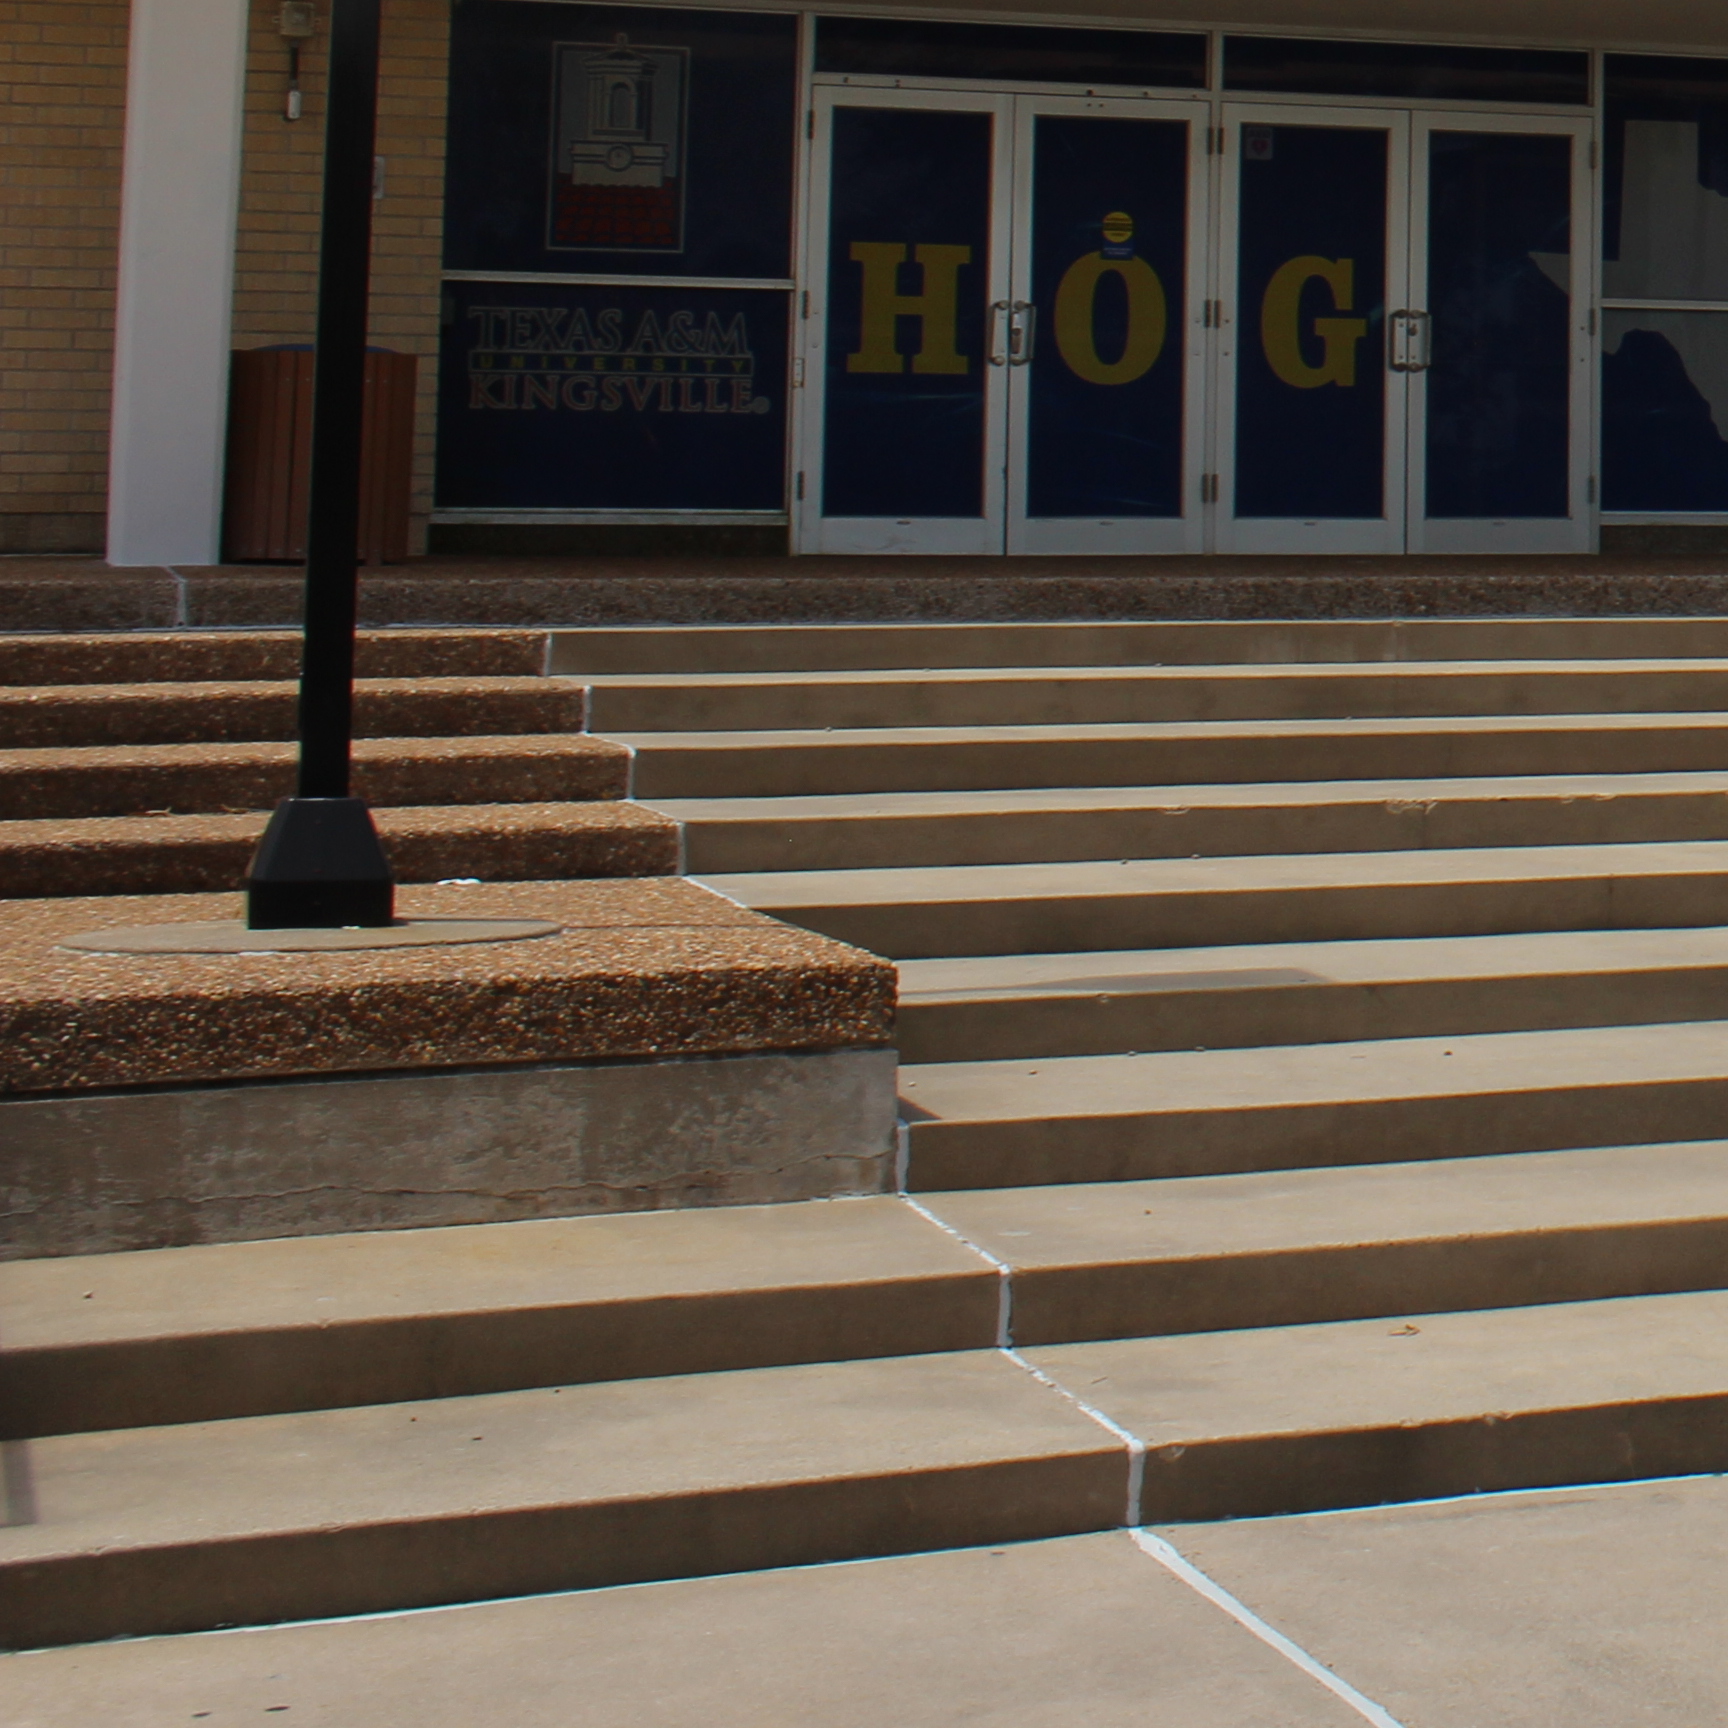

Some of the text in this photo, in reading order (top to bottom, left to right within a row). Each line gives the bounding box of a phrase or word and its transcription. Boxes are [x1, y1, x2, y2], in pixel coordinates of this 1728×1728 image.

[467, 305, 752, 355] TEXAS A&M
[846, 241, 1367, 389] HOG
[479, 354, 746, 373] UNIVERSITY
[468, 374, 754, 414] KINGSVILLE
